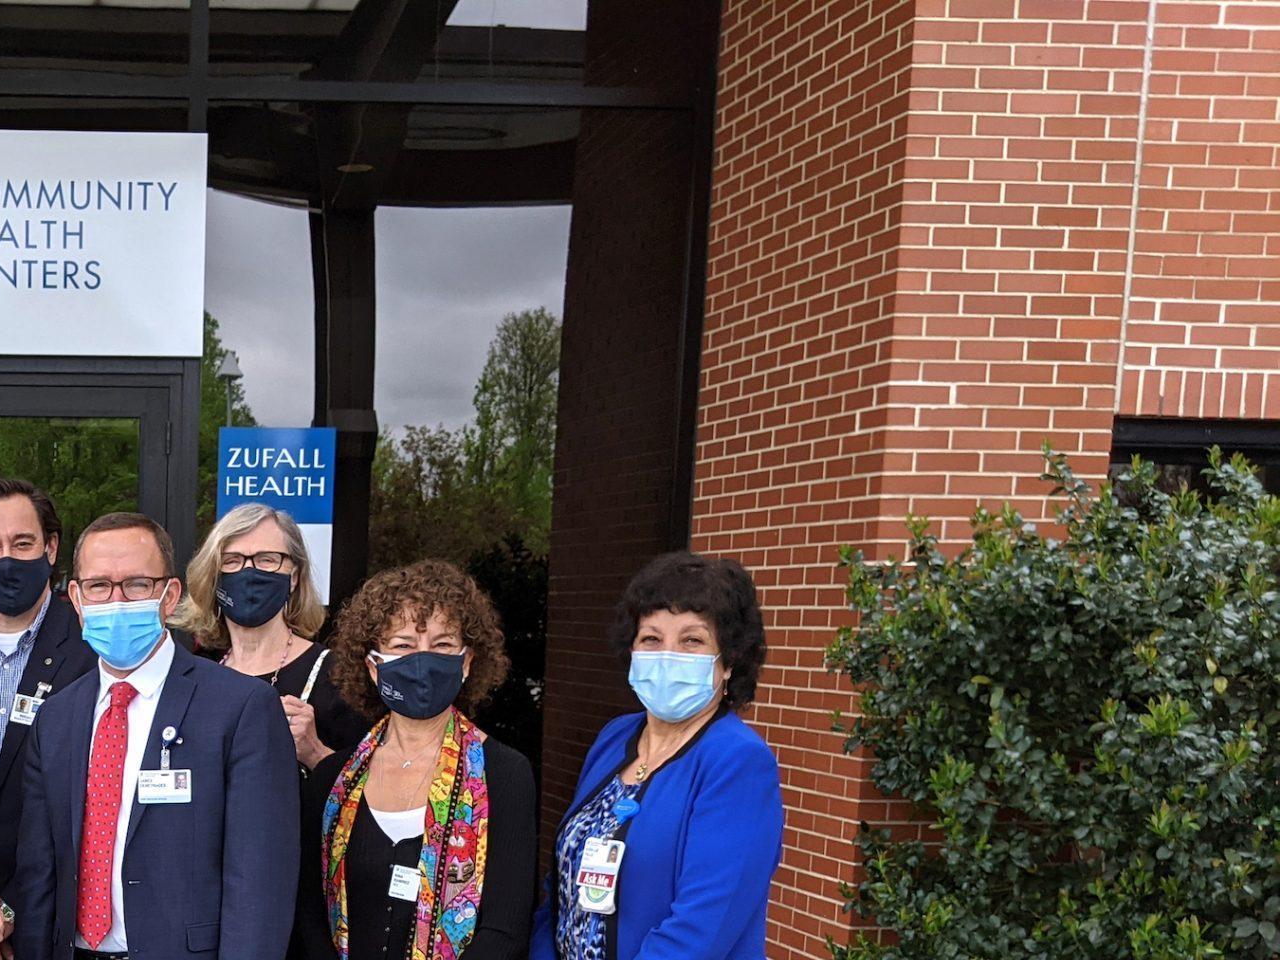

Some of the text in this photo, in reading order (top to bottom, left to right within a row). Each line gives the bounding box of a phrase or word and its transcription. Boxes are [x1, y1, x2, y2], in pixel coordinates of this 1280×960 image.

[227, 447, 325, 469] ZUFALL
[225, 476, 326, 497] HEALTH
[583, 872, 610, 887] Ask Me
